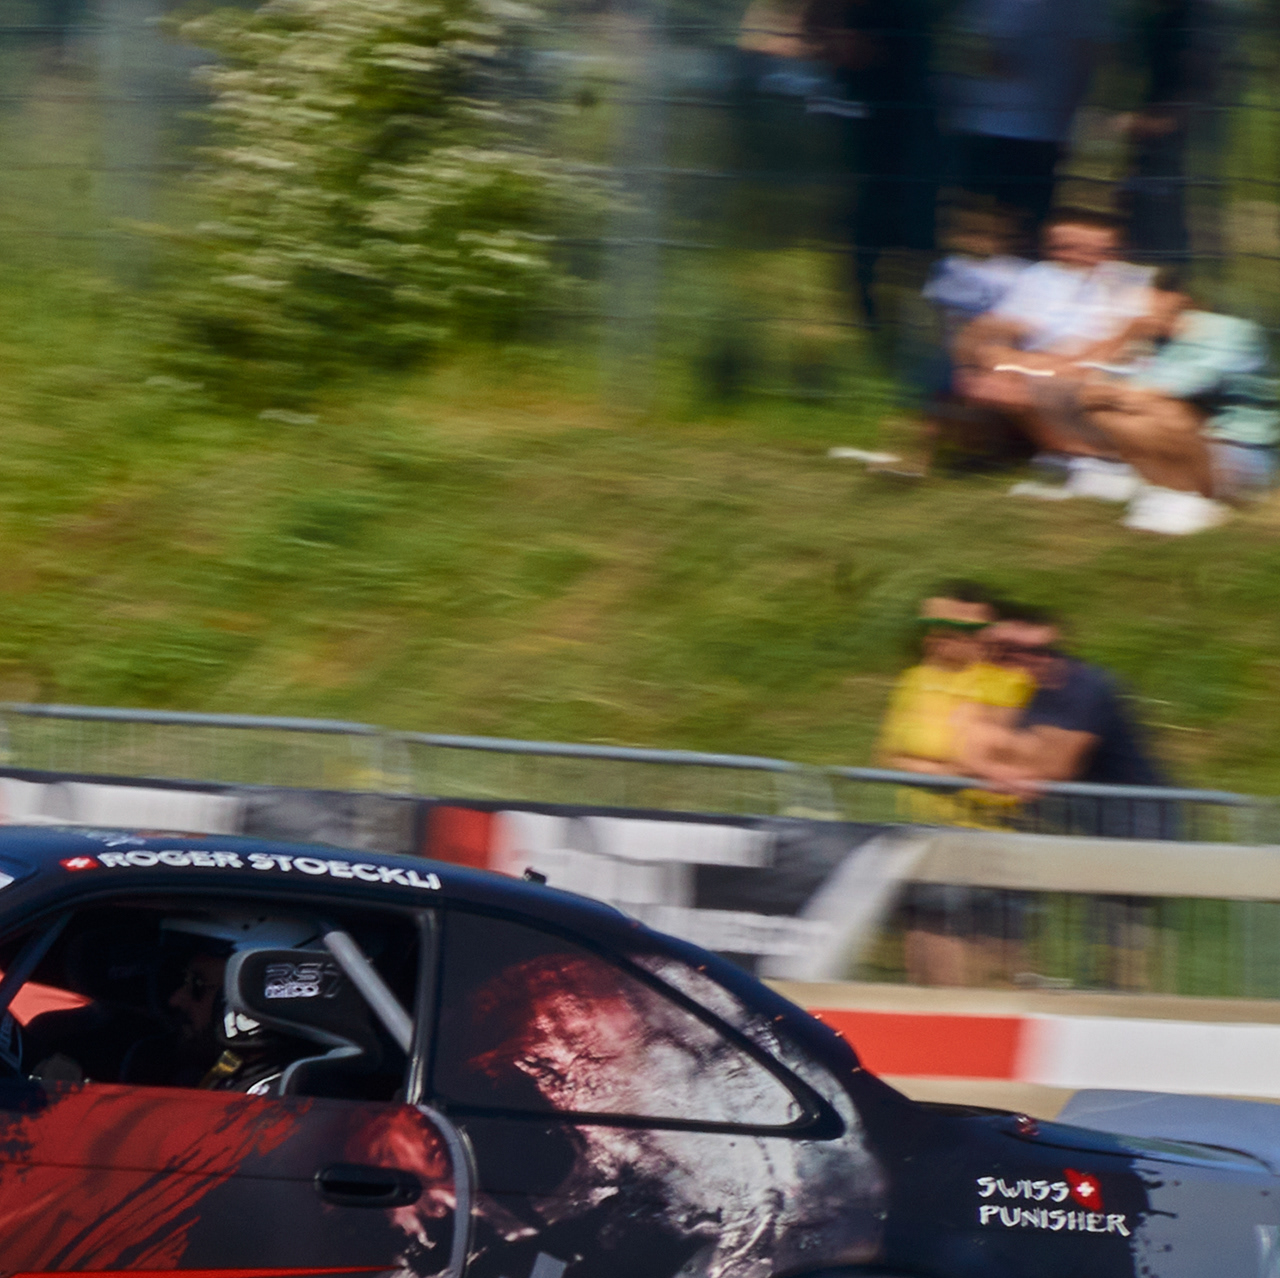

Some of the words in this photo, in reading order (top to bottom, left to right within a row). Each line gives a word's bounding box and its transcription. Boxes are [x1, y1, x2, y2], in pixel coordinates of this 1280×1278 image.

[96, 849, 243, 868] ROGER
[247, 852, 441, 890] STOECKLI
[976, 1176, 1069, 1202] SWISS
[978, 1205, 1131, 1237] PUNISHER
